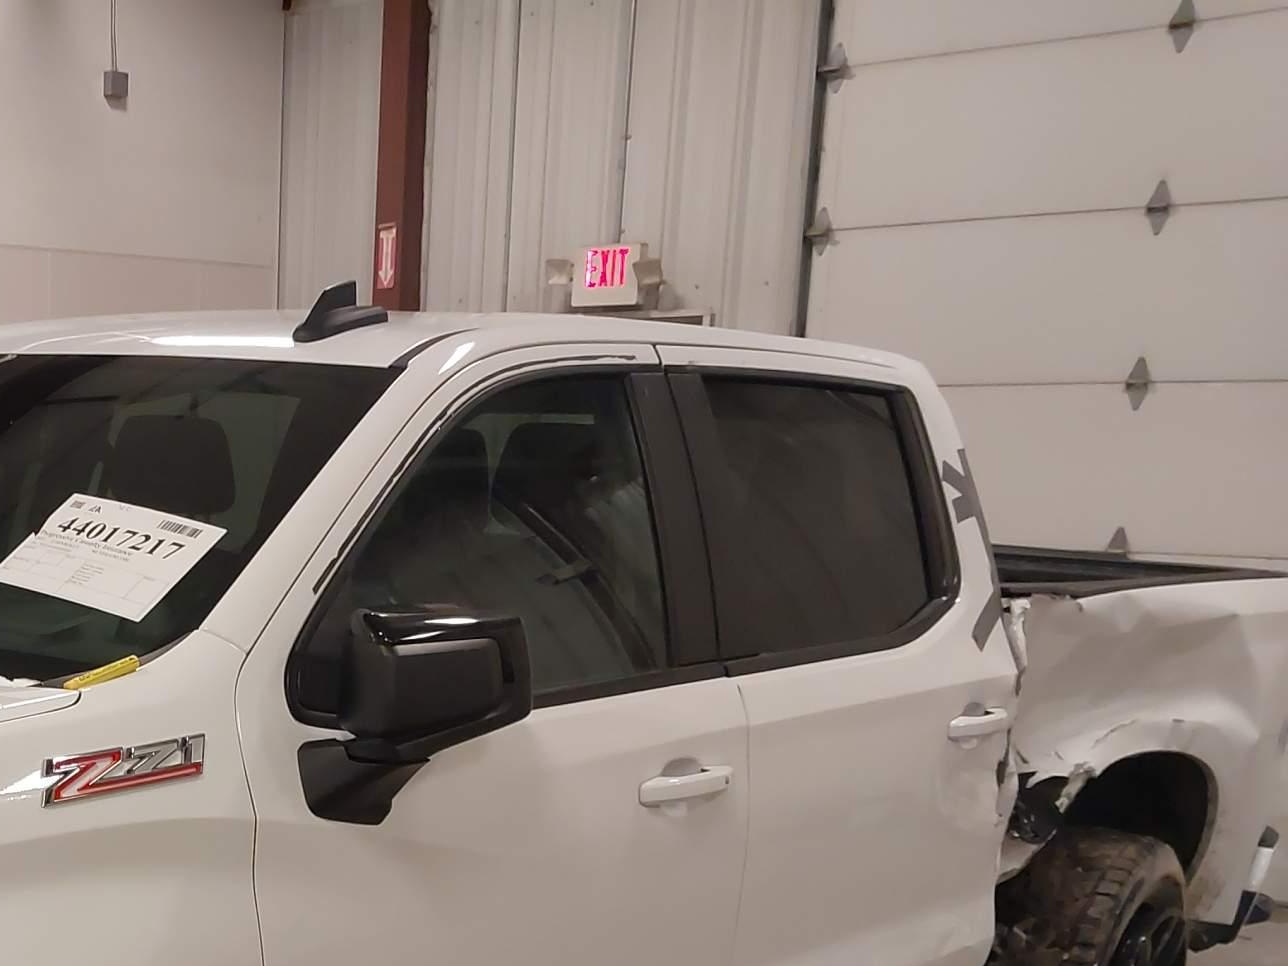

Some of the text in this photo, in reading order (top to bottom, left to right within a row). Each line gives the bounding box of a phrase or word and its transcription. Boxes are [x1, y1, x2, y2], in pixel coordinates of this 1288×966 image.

[585, 248, 629, 288] EXIT
[57, 517, 186, 559] 44017217
[41, 733, 206, 808] Z71
